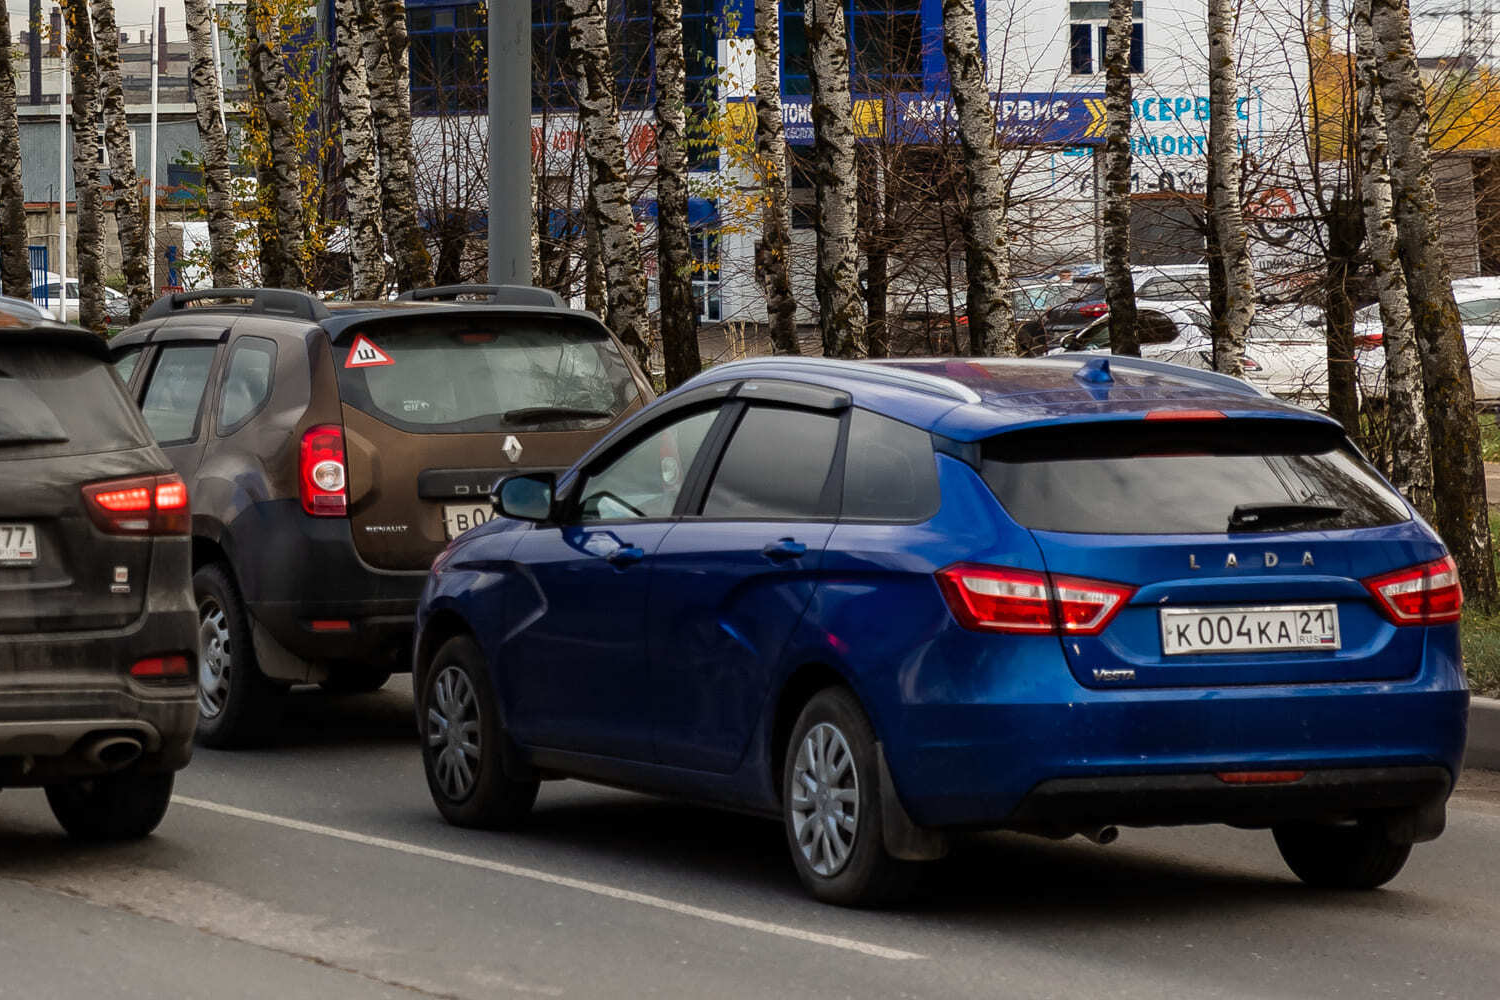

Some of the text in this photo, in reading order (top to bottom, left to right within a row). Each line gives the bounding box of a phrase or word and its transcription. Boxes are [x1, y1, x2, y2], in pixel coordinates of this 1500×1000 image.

[358, 348, 376, 360] Ш
[1189, 551, 1315, 569] LADA
[1299, 635, 1320, 644] RUS
